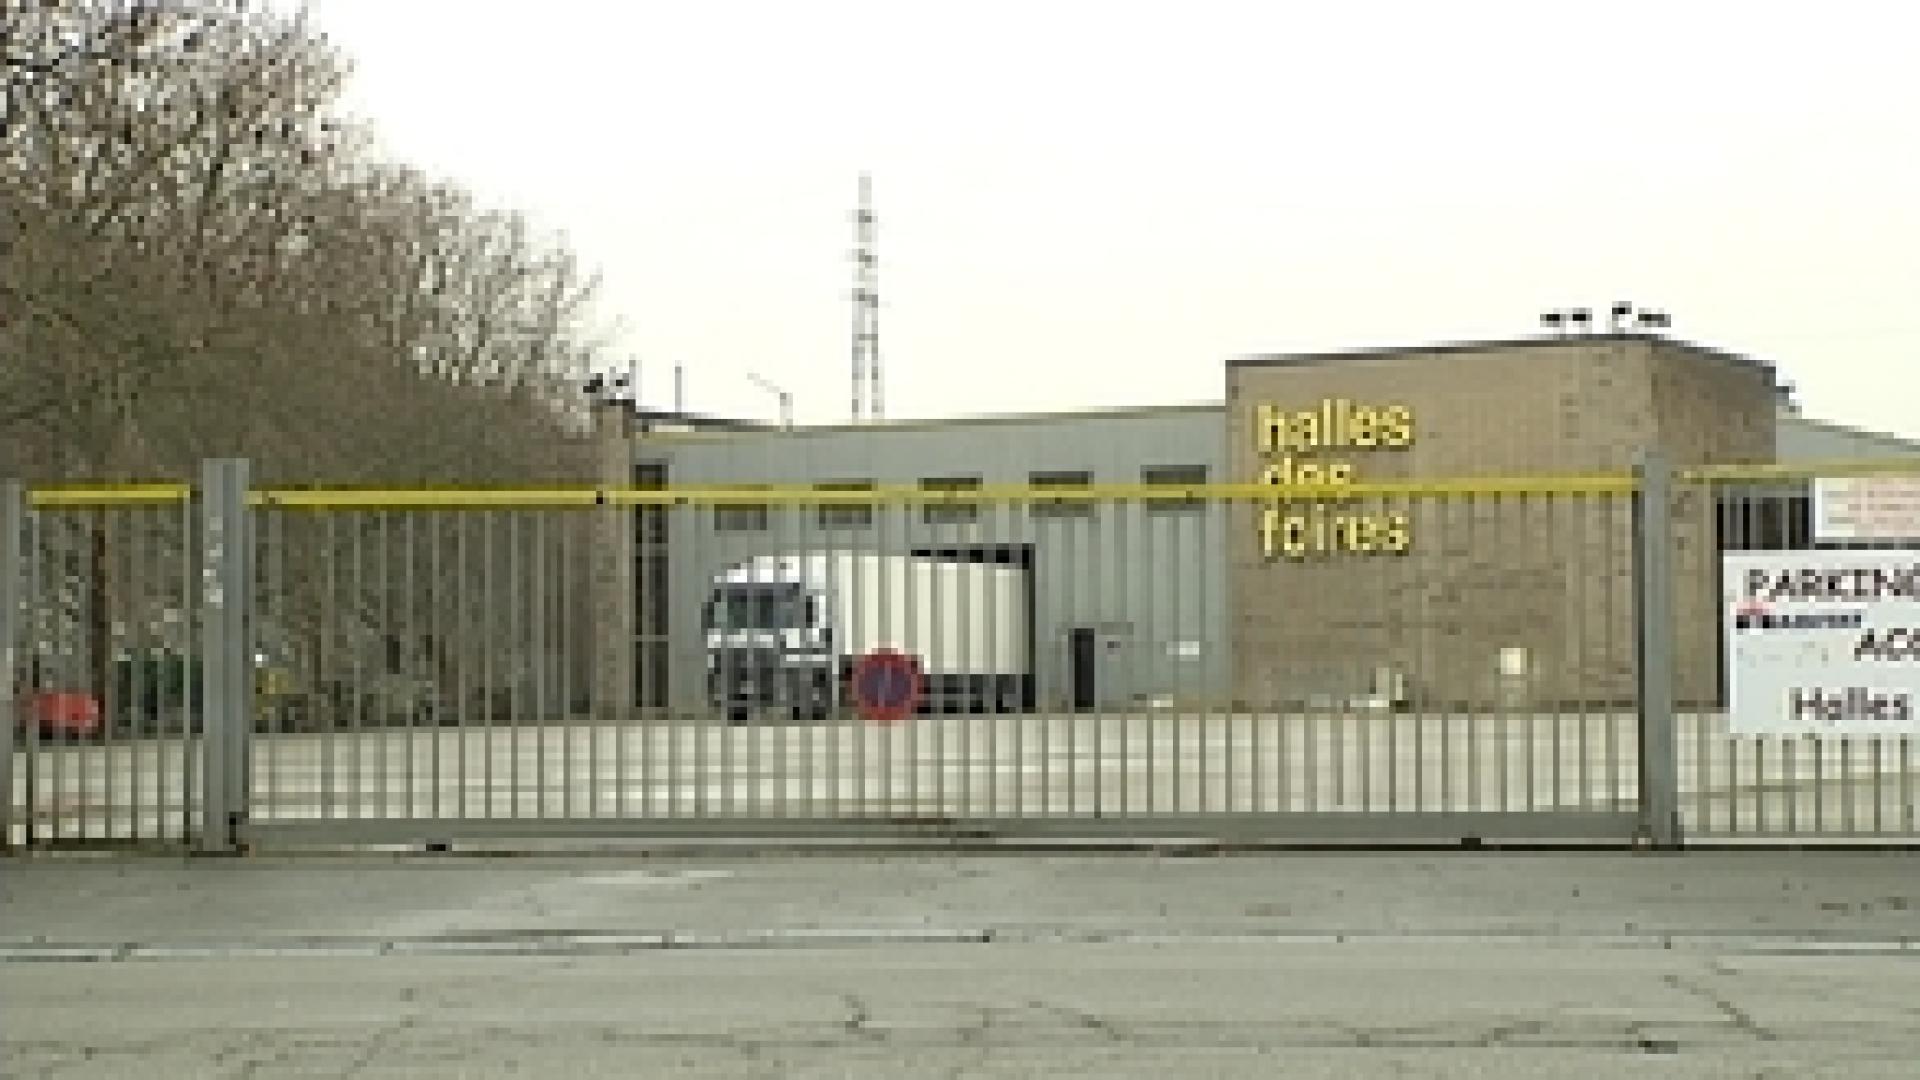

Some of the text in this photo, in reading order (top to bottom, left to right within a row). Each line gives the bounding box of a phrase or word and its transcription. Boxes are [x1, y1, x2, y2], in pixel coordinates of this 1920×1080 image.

[1258, 398, 1412, 451] halles
[1261, 500, 1410, 556] foires
[1790, 687, 1912, 721] Halles
